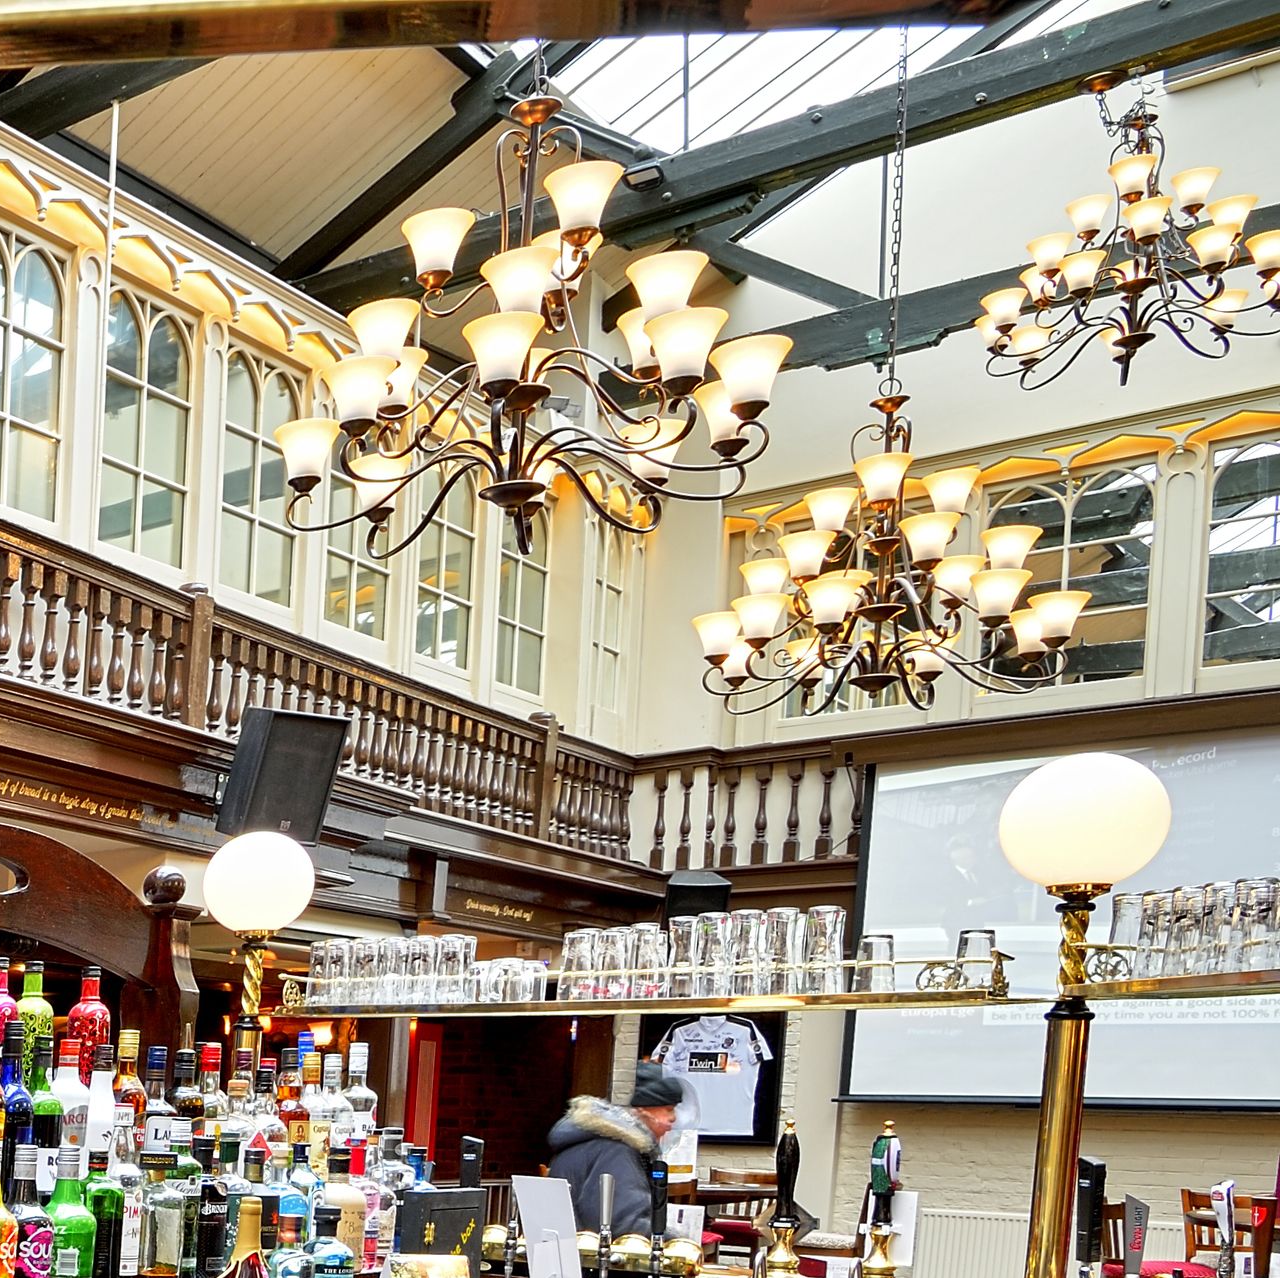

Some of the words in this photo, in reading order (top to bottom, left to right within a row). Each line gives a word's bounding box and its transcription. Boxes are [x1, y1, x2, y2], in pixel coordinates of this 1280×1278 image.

[9, 780, 19, 798] of
[1148, 1011, 1170, 1022] you
[1173, 1011, 1197, 1019] are
[1203, 1009, 1226, 1019] not
[690, 1057, 715, 1069] Twin
